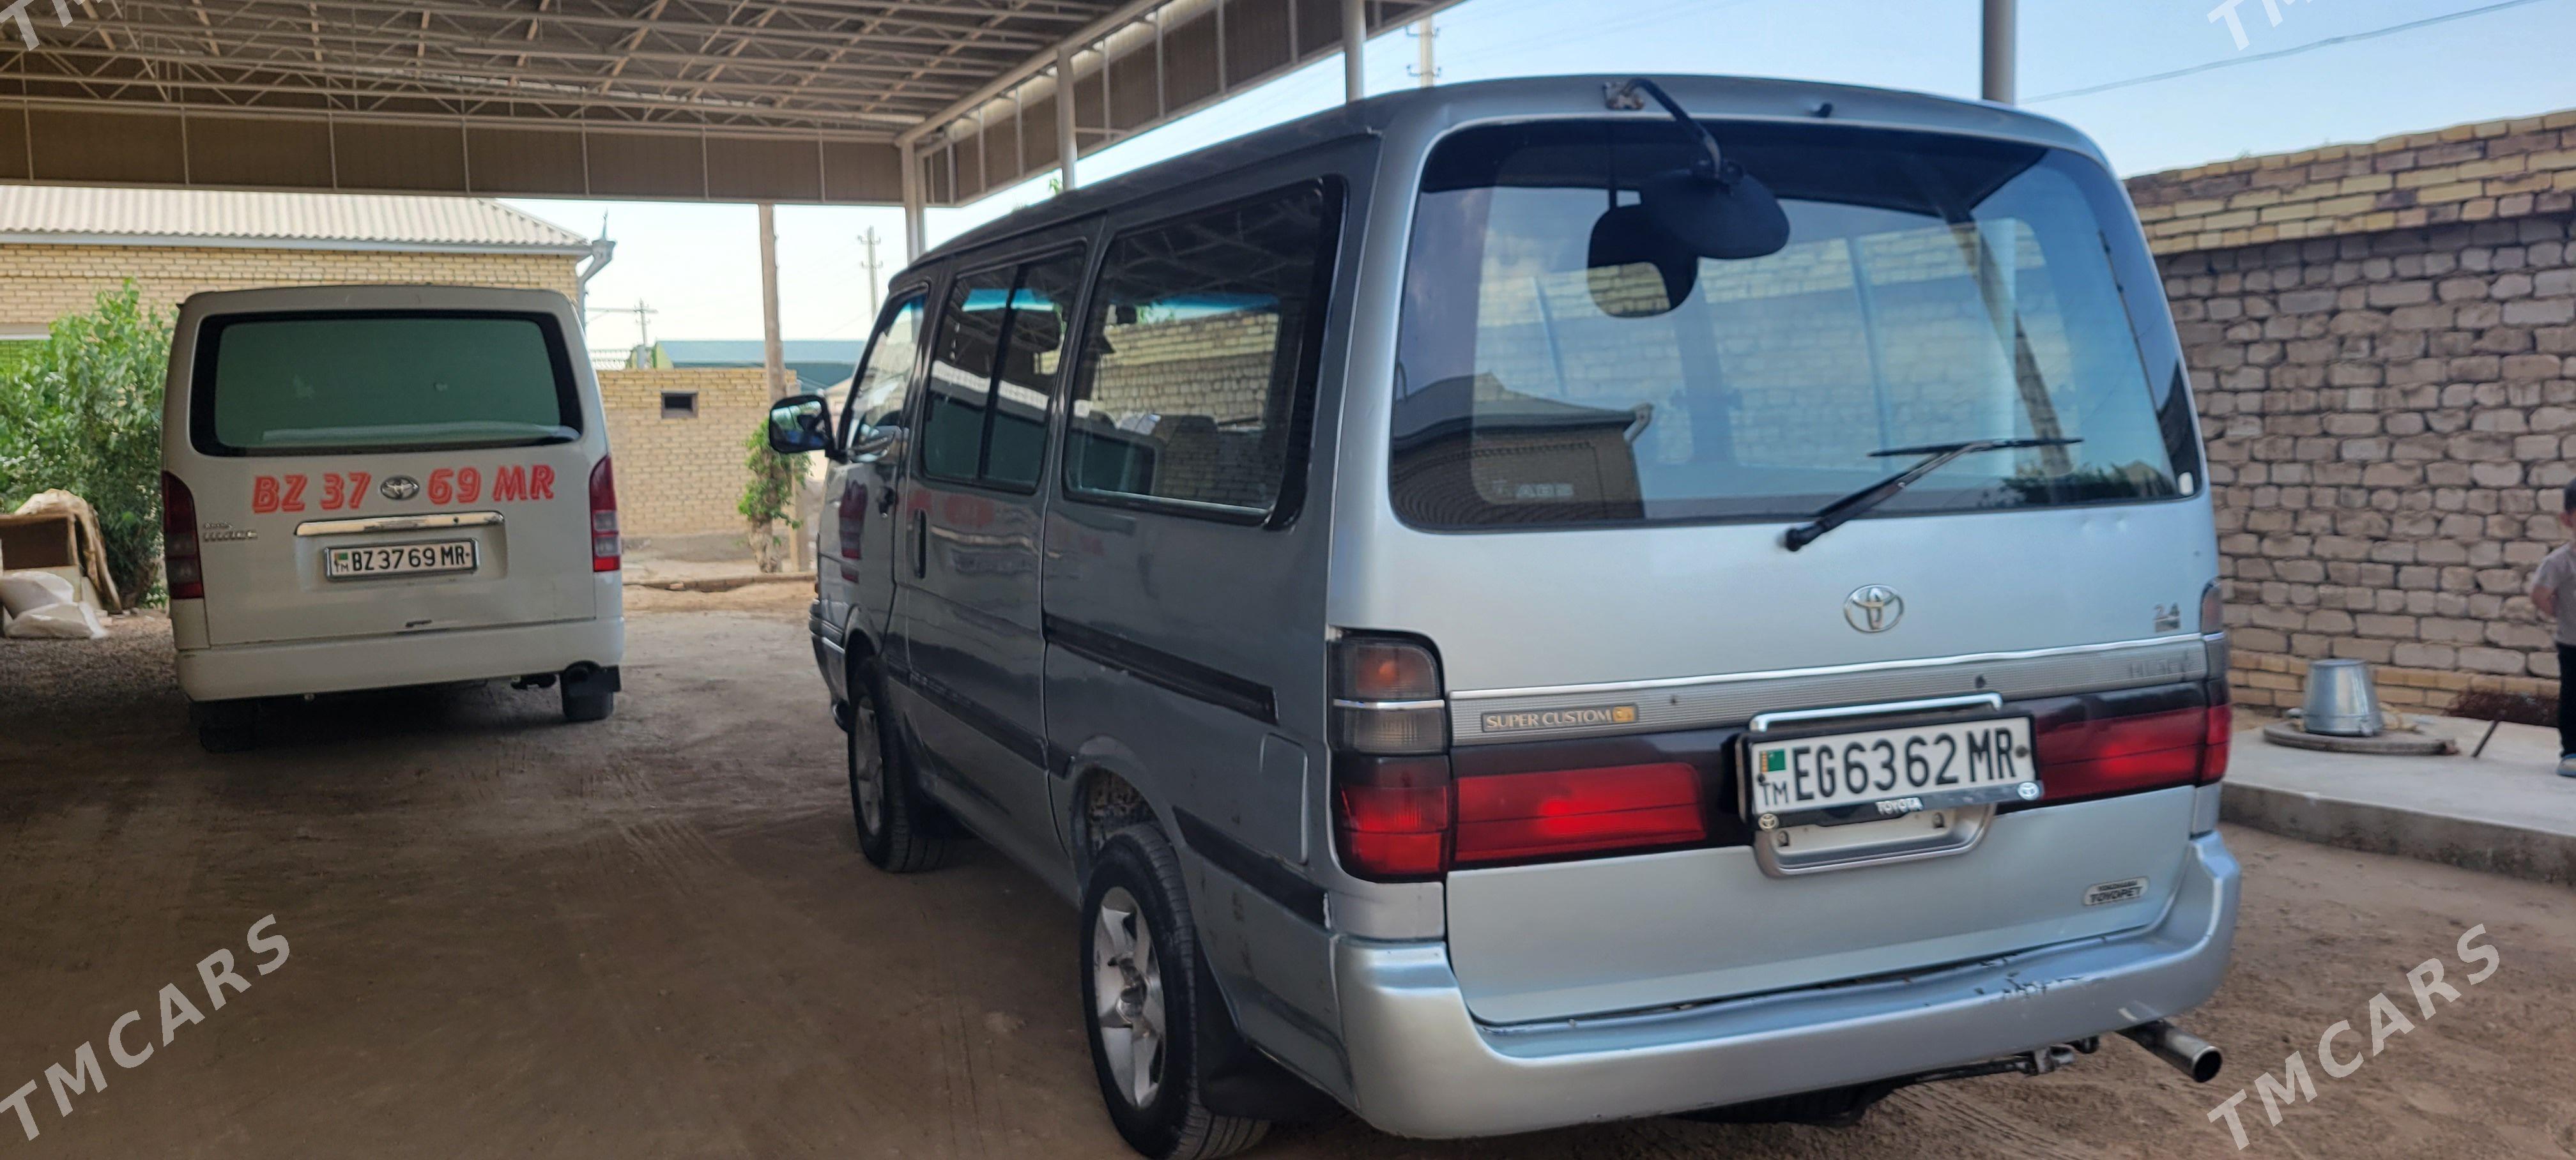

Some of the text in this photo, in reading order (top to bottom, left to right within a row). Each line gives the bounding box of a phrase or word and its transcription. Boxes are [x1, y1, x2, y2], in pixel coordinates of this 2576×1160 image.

[252, 465, 555, 513] BZ 37 69 MR
[1486, 714, 1539, 728] SUPER
[1542, 709, 1612, 727] CUSTOM
[1759, 780, 1789, 806] TM
[1874, 797, 1924, 815] TOYOTA
